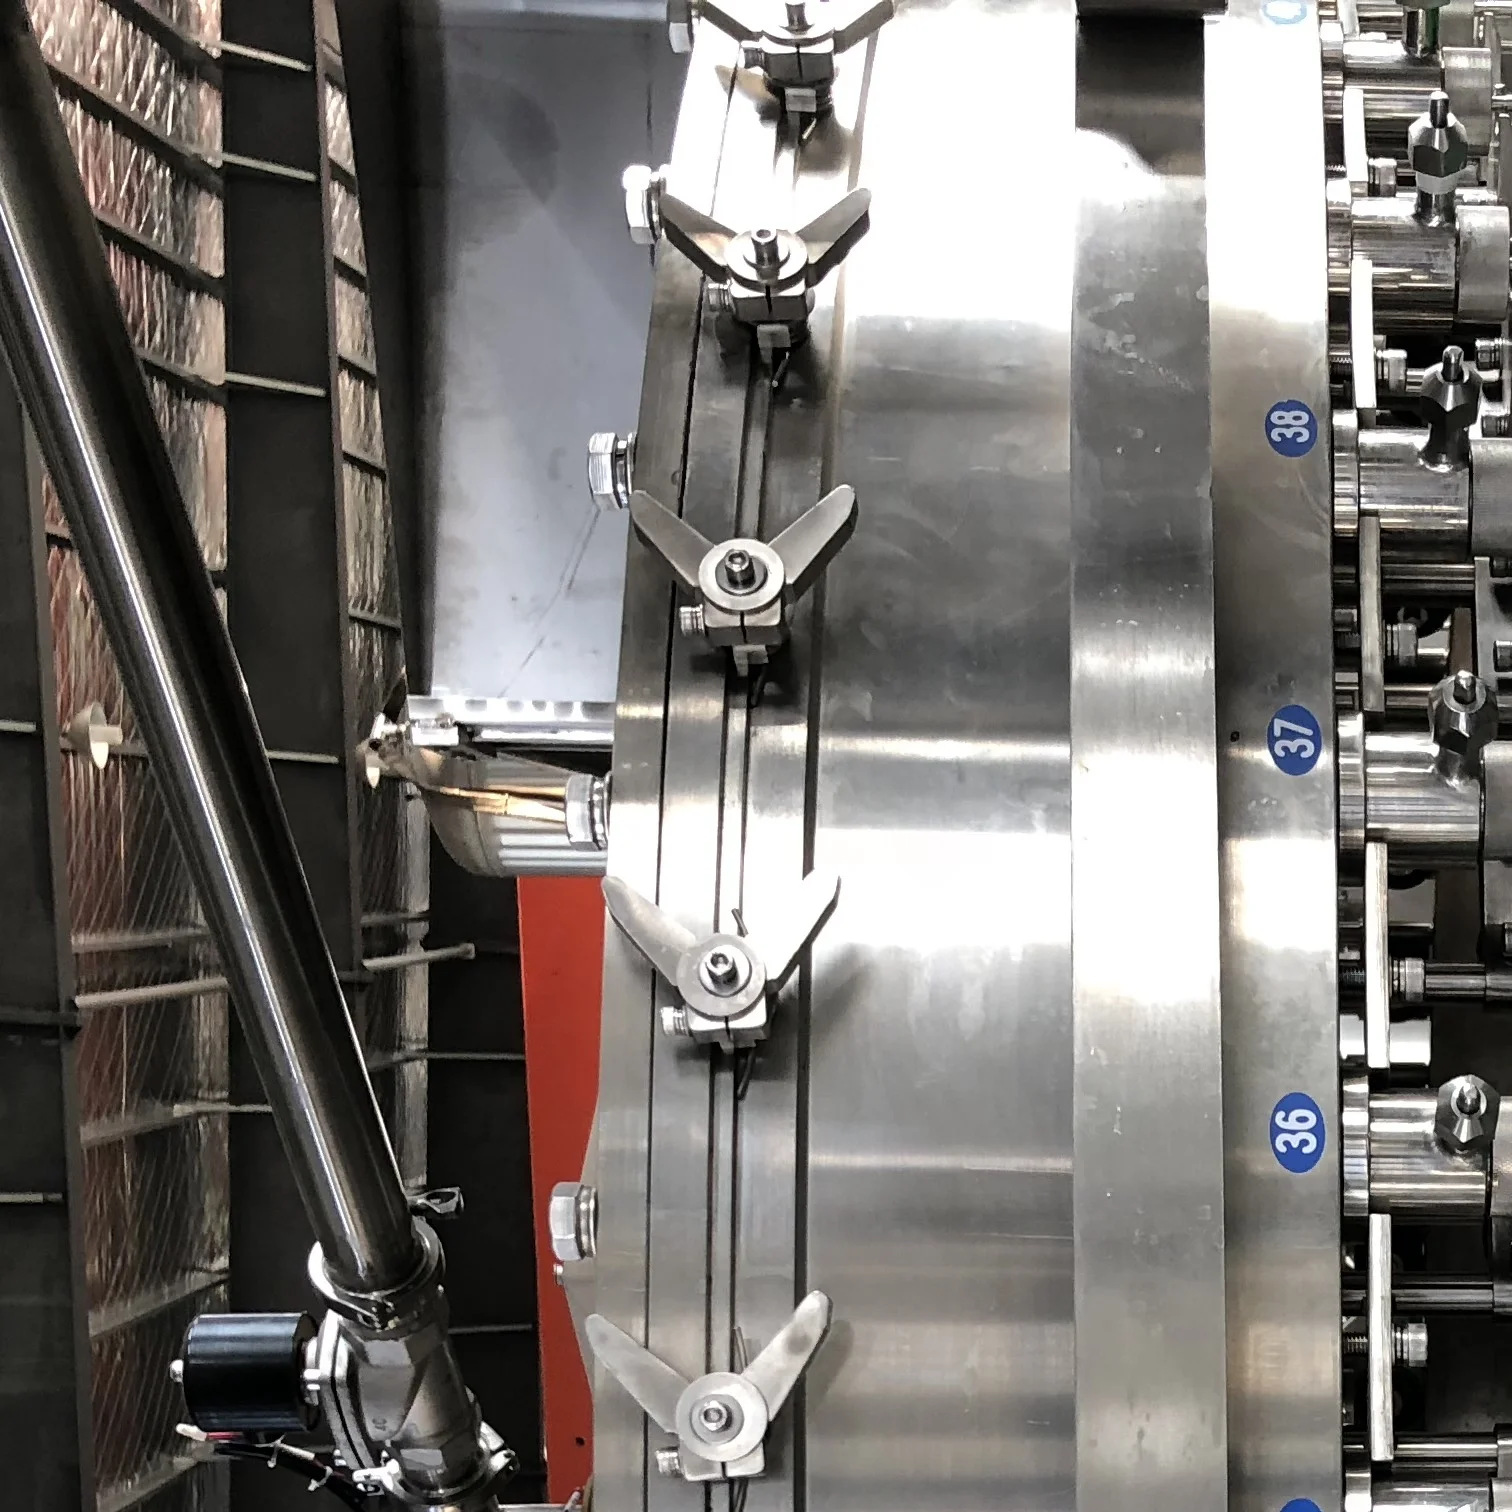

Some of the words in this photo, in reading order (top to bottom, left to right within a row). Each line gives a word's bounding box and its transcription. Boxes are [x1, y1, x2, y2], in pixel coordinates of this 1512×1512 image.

[1270, 410, 1310, 443] 38
[1274, 718, 1315, 757] 37
[1274, 1108, 1317, 1154] 36
